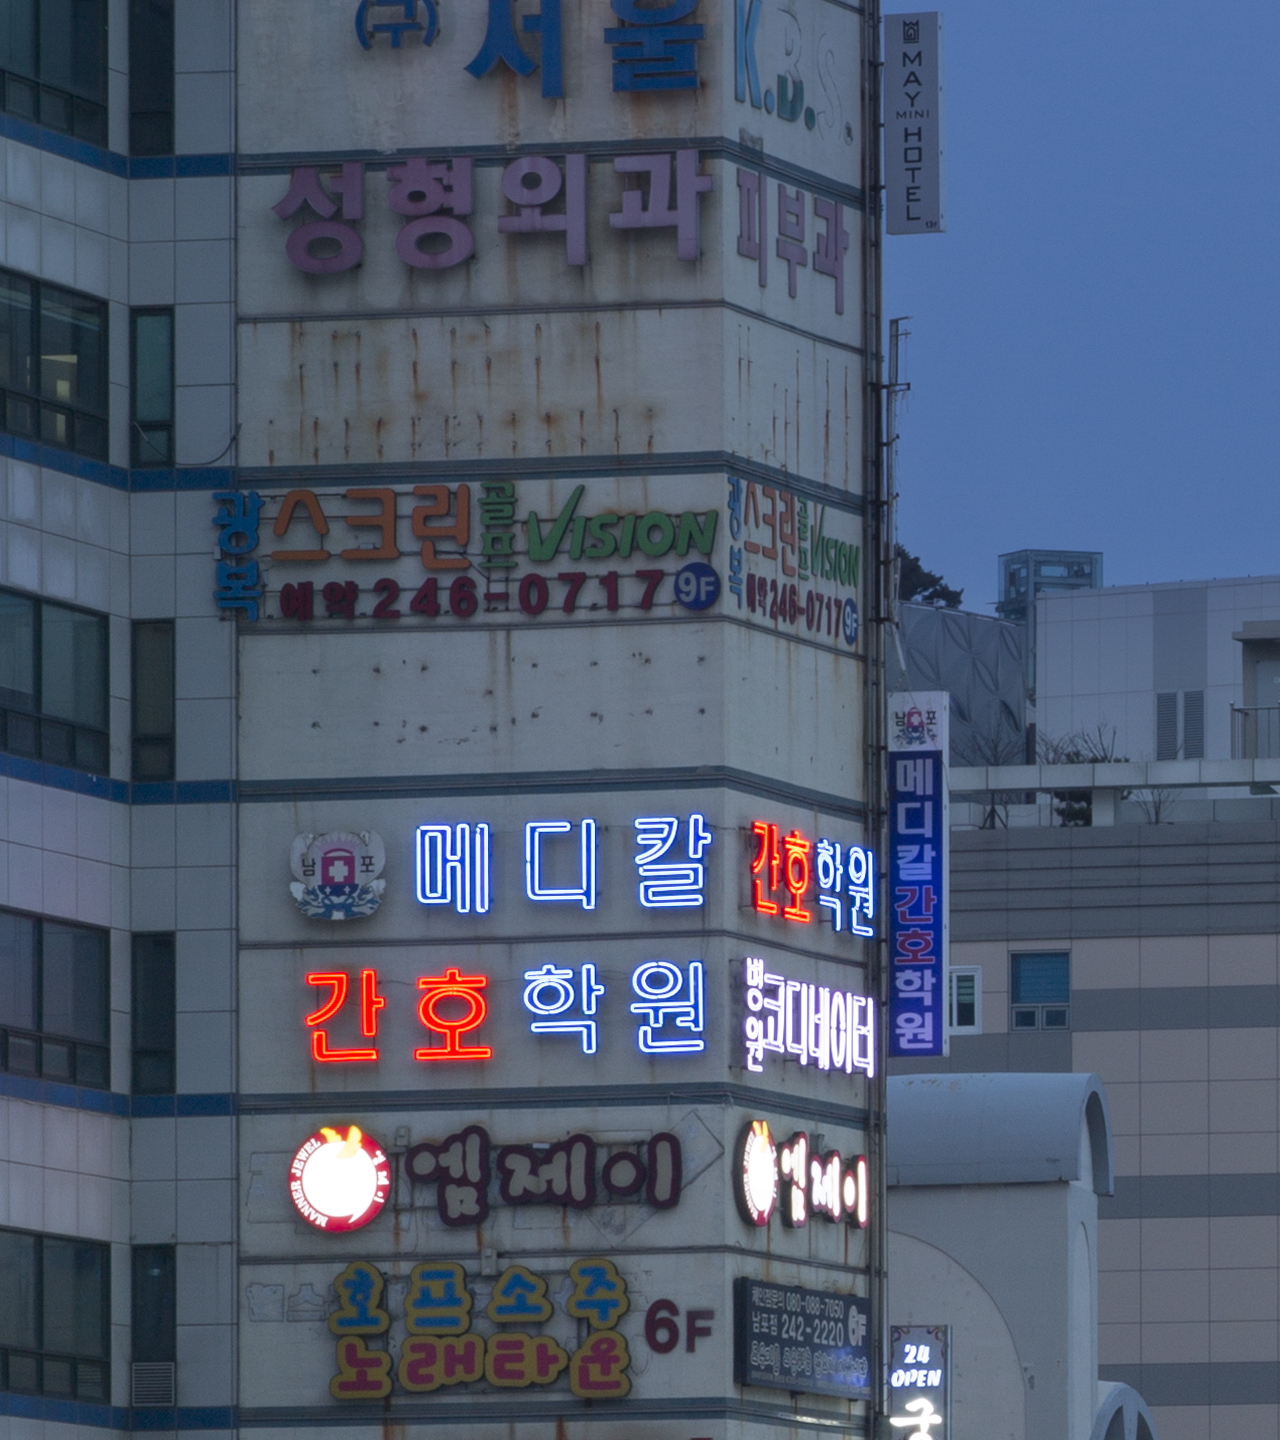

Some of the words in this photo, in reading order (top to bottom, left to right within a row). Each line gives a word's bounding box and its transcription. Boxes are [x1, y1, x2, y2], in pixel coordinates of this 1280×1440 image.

[901, 51, 923, 106] MAY
[896, 110, 930, 120] MINI
[903, 127, 923, 223] HOTEL
[271, 150, 713, 274] 성형외과
[736, 169, 849, 315] 피부과
[213, 490, 266, 621] 광복
[270, 483, 471, 570] 스크린
[478, 481, 518, 568] 골프
[528, 485, 718, 560] VISION
[744, 482, 796, 576] 스크린
[810, 506, 860, 588] VISION
[280, 580, 359, 621] 예약
[372, 570, 664, 619] 246-0717
[678, 570, 716, 604] 9F
[769, 578, 844, 639] 246-0717
[415, 815, 711, 913] 메디칼
[747, 958, 763, 1072] 병원
[764, 974, 875, 1078] 코디네이터
[291, 1137, 321, 1177] JEWEL
[405, 1125, 682, 1226] 엠제이
[781, 1131, 869, 1228] 엠제이
[290, 1179, 328, 1227] MANNER
[645, 1299, 714, 1353] 6F
[752, 1311, 778, 1336] 남포점
[782, 1314, 844, 1347] 242-2220
[848, 1305, 866, 1346] 6F
[904, 1344, 930, 1364] 24
[331, 1332, 630, 1398] 노래타운
[891, 1369, 942, 1387] OPEN
